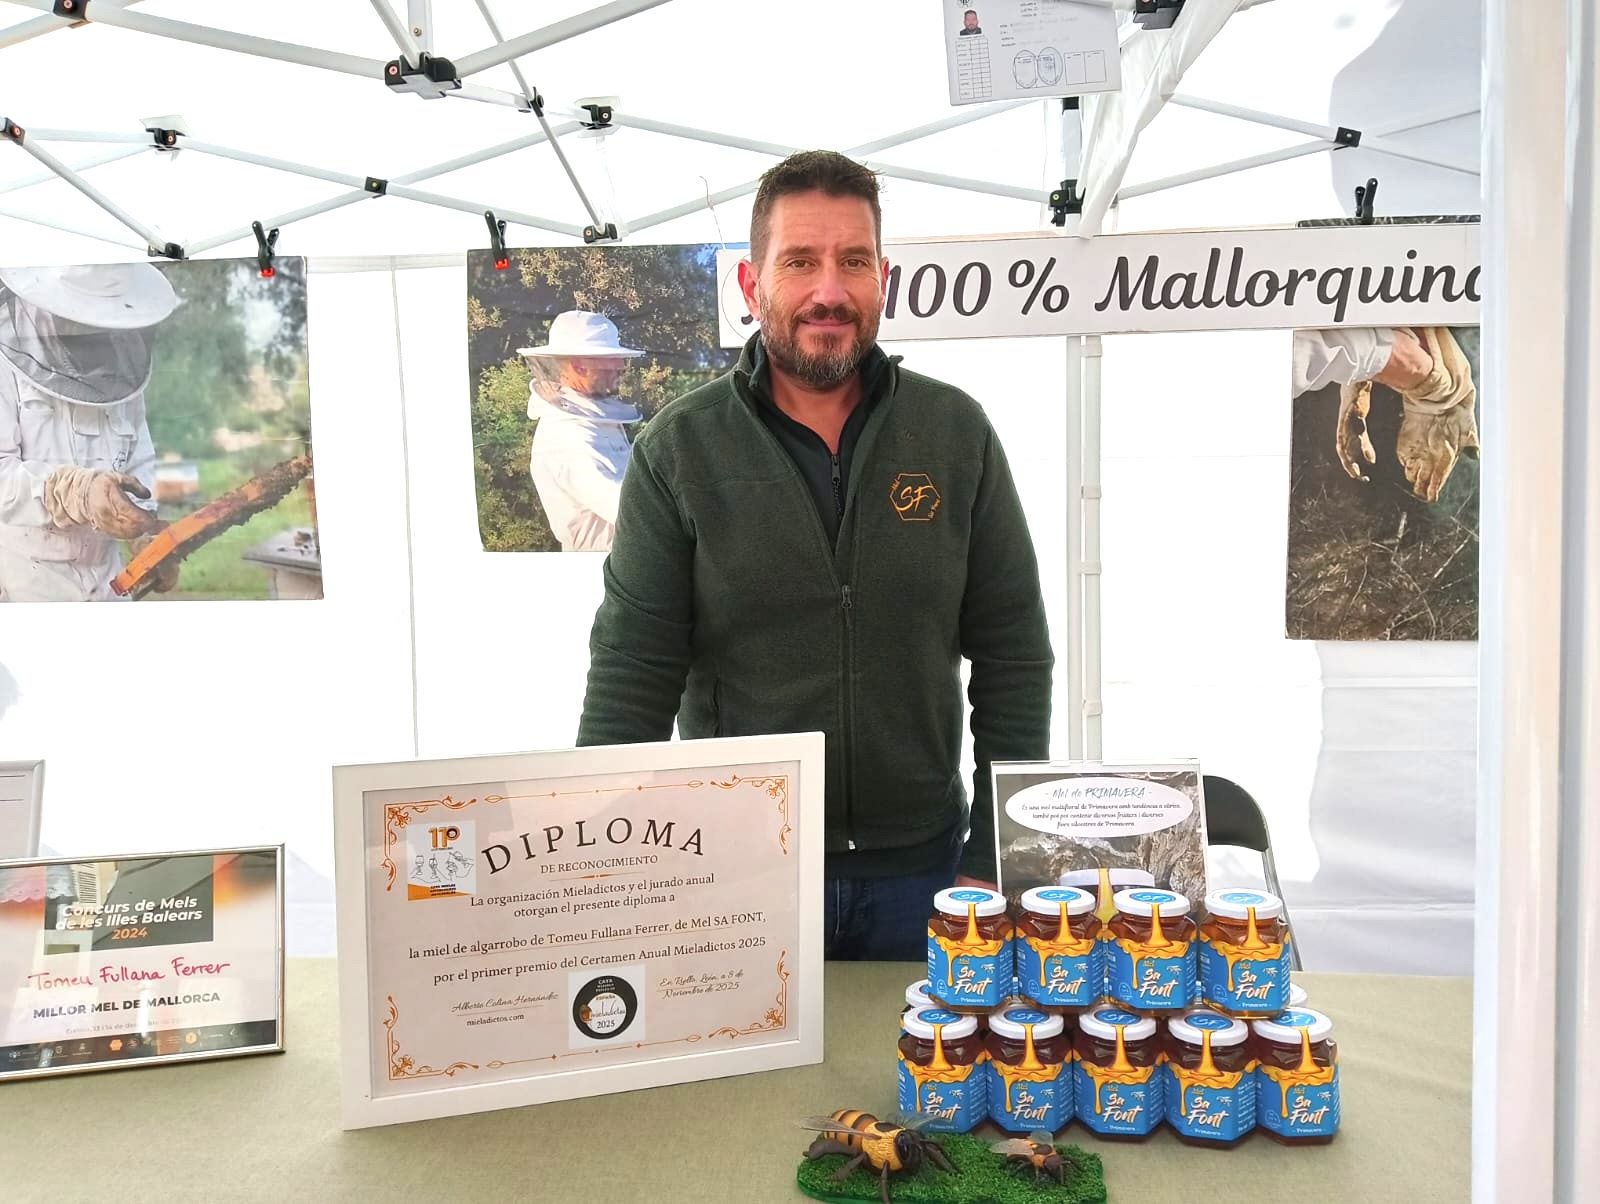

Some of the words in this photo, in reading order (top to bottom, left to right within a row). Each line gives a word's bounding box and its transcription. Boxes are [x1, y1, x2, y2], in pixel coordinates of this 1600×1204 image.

[885, 261, 992, 319] 100
[1007, 256, 1070, 316] %
[1084, 786, 1145, 799] PRIMAVERA
[481, 817, 704, 875] DIPLOMA
[540, 864, 556, 874] DE
[557, 854, 659, 873] RECONOCIMIENTO
[471, 896, 484, 906] La
[487, 889, 560, 907] organización
[562, 881, 626, 898] Mieladictos
[628, 883, 635, 893] y
[637, 879, 648, 891] el
[648, 874, 684, 892] jurado
[685, 872, 715, 887] anual
[62, 903, 130, 917] Concurs
[134, 899, 155, 912] de
[160, 896, 197, 910] Mels
[513, 902, 559, 919] otorgan
[560, 901, 572, 914] el
[573, 899, 621, 915] presente
[622, 894, 667, 910] diploma
[668, 893, 676, 902] a
[56, 917, 77, 930] de
[79, 917, 103, 929] les
[106, 914, 138, 927] Illes
[141, 909, 204, 925] Balears
[111, 926, 148, 940] 2024
[409, 947, 420, 959] la
[423, 944, 451, 957] miel
[452, 941, 468, 954] de
[470, 936, 528, 955] algarrobo
[530, 934, 545, 946] de
[547, 931, 588, 945] Tomeu
[591, 925, 632, 940] Fullana
[635, 922, 672, 936] Ferrer,
[674, 918, 689, 931] de
[691, 915, 712, 929] Mel
[714, 915, 729, 926] SA
[731, 911, 767, 925] FONT,
[433, 973, 455, 986] por
[457, 969, 468, 981] el
[471, 966, 513, 982] primer
[515, 960, 558, 977] premio
[560, 956, 578, 969] del
[580, 951, 637, 967] Certamen
[638, 946, 672, 960] Anual
[674, 940, 737, 956] Mieladictos
[738, 936, 767, 950] 2025
[27, 971, 94, 991] Tomeu
[99, 965, 167, 985] Fullana
[170, 956, 232, 977] Ferrer
[958, 966, 976, 978] Sa
[1051, 966, 1069, 978] Sa
[1143, 969, 1161, 981] Sa
[1239, 971, 1257, 983] Sa
[715, 981, 741, 992] 2025
[954, 977, 992, 995] Font
[1047, 977, 1087, 995] Font
[1139, 979, 1179, 998] Font
[1235, 981, 1275, 1001] Font
[33, 1004, 87, 1019] MILLOR
[91, 1000, 120, 1013] MEL
[123, 998, 142, 1010] DE
[146, 992, 221, 1010] MALLORCA
[466, 1014, 525, 1027] mieladictos.com
[596, 1019, 616, 1029] 2025
[926, 1092, 944, 1104] Sa
[1016, 1091, 1034, 1104] Sa
[1106, 1093, 1125, 1106] Sa
[1191, 1096, 1211, 1109] Sa
[1292, 1096, 1312, 1109] Sa
[925, 1103, 961, 1121] Font
[1013, 1103, 1053, 1121] Font
[1102, 1105, 1144, 1124] Font
[1187, 1110, 1230, 1128] Font
[1289, 1105, 1330, 1127] Font
